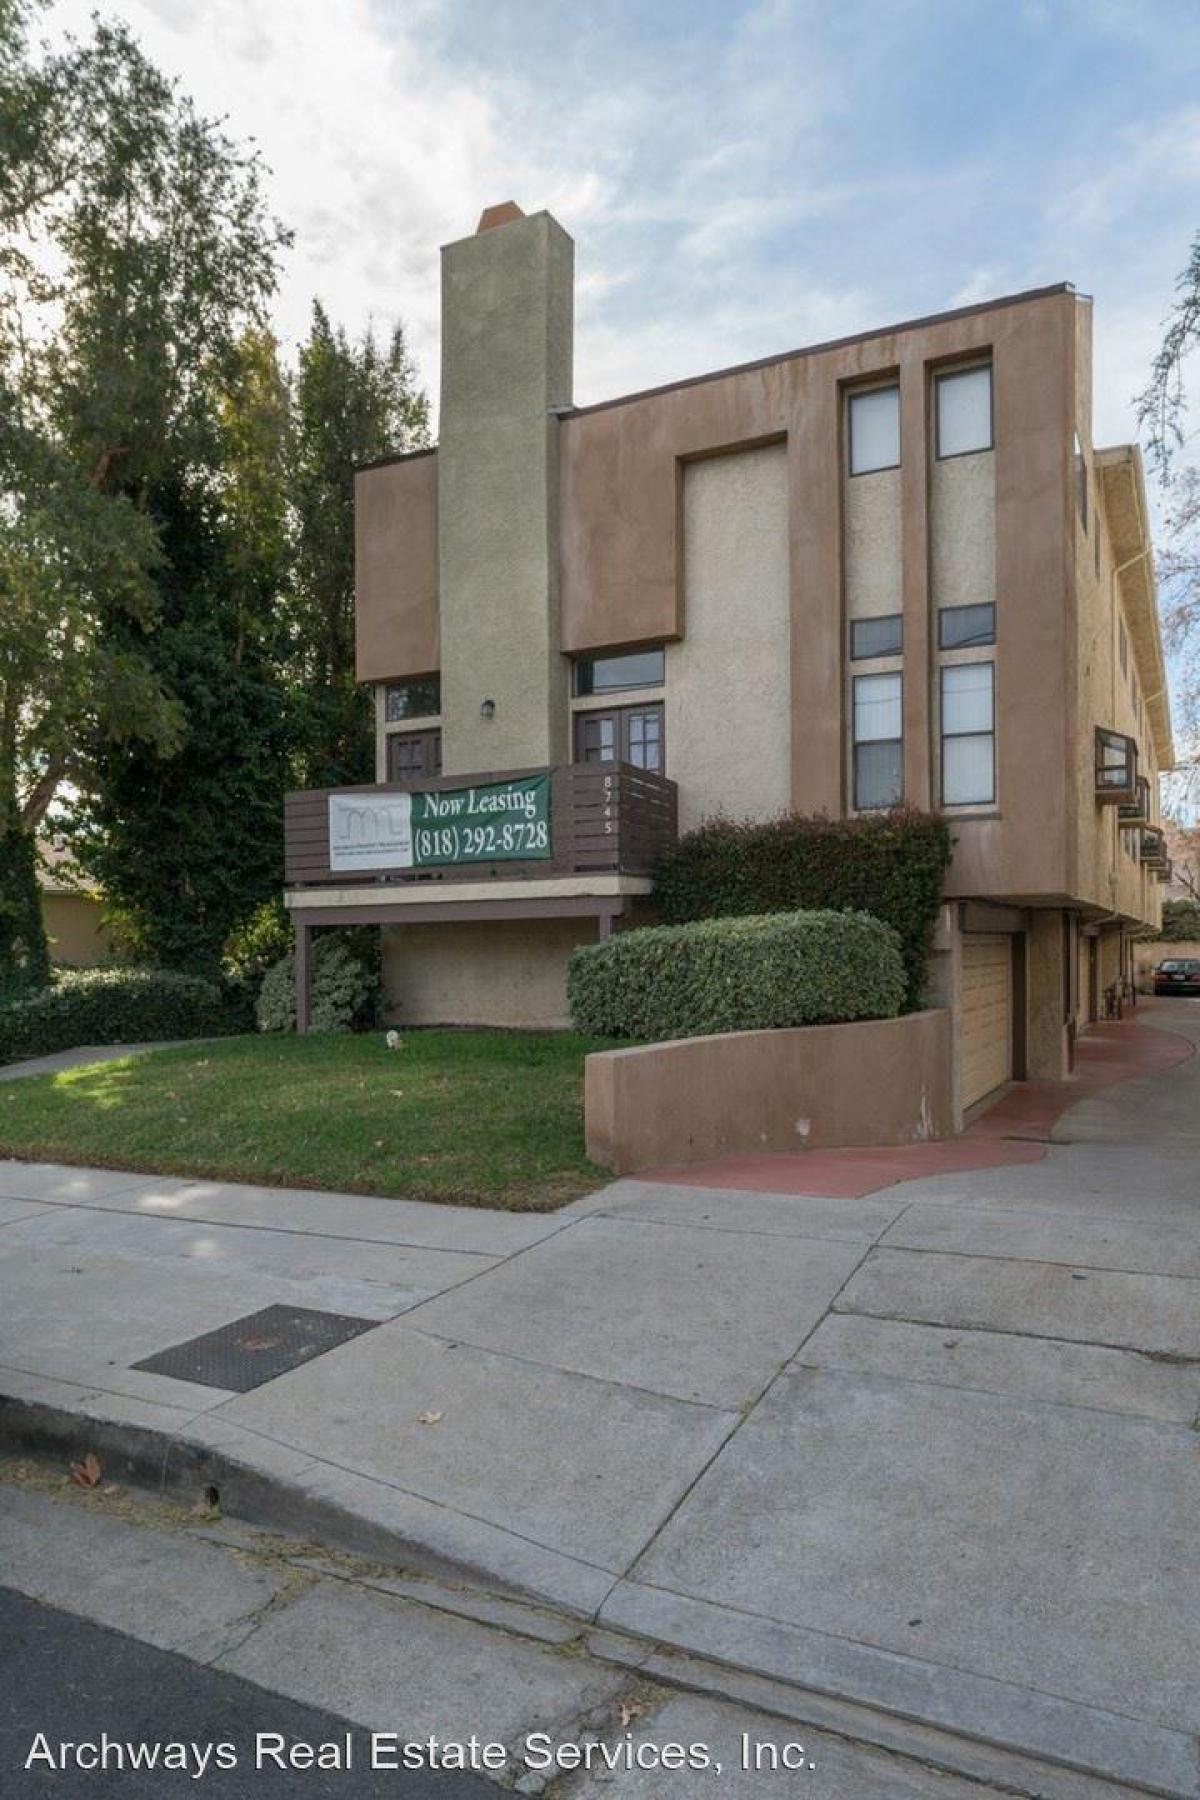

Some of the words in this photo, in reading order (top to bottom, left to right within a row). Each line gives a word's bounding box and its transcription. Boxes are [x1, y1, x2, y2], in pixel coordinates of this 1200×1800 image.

[423, 791, 464, 818] Now
[467, 786, 536, 817] Leasing
[603, 776, 613, 834] 8745
[415, 826, 459, 862] (818)
[463, 821, 548, 855] 292-8728
